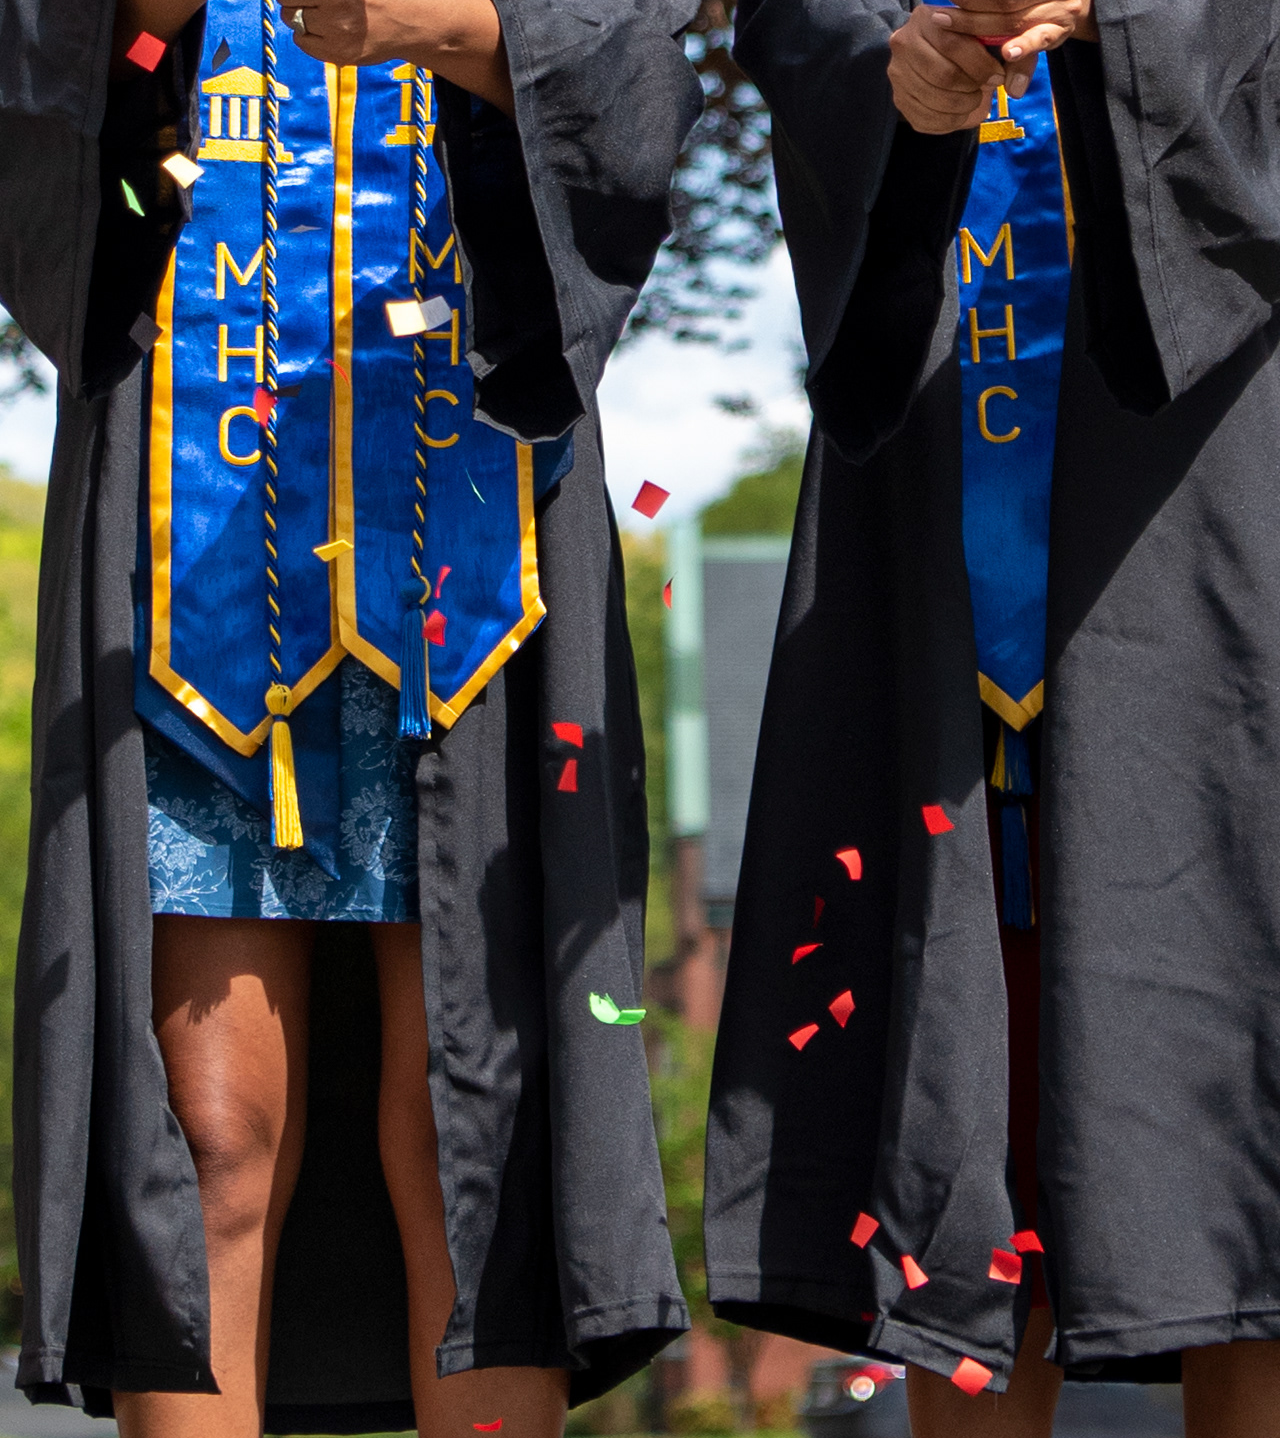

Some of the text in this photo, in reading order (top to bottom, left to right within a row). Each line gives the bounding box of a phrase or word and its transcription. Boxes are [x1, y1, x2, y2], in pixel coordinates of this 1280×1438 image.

[215, 242, 267, 466] MHC
[408, 227, 463, 448] MHC
[959, 223, 1021, 443] MHC
